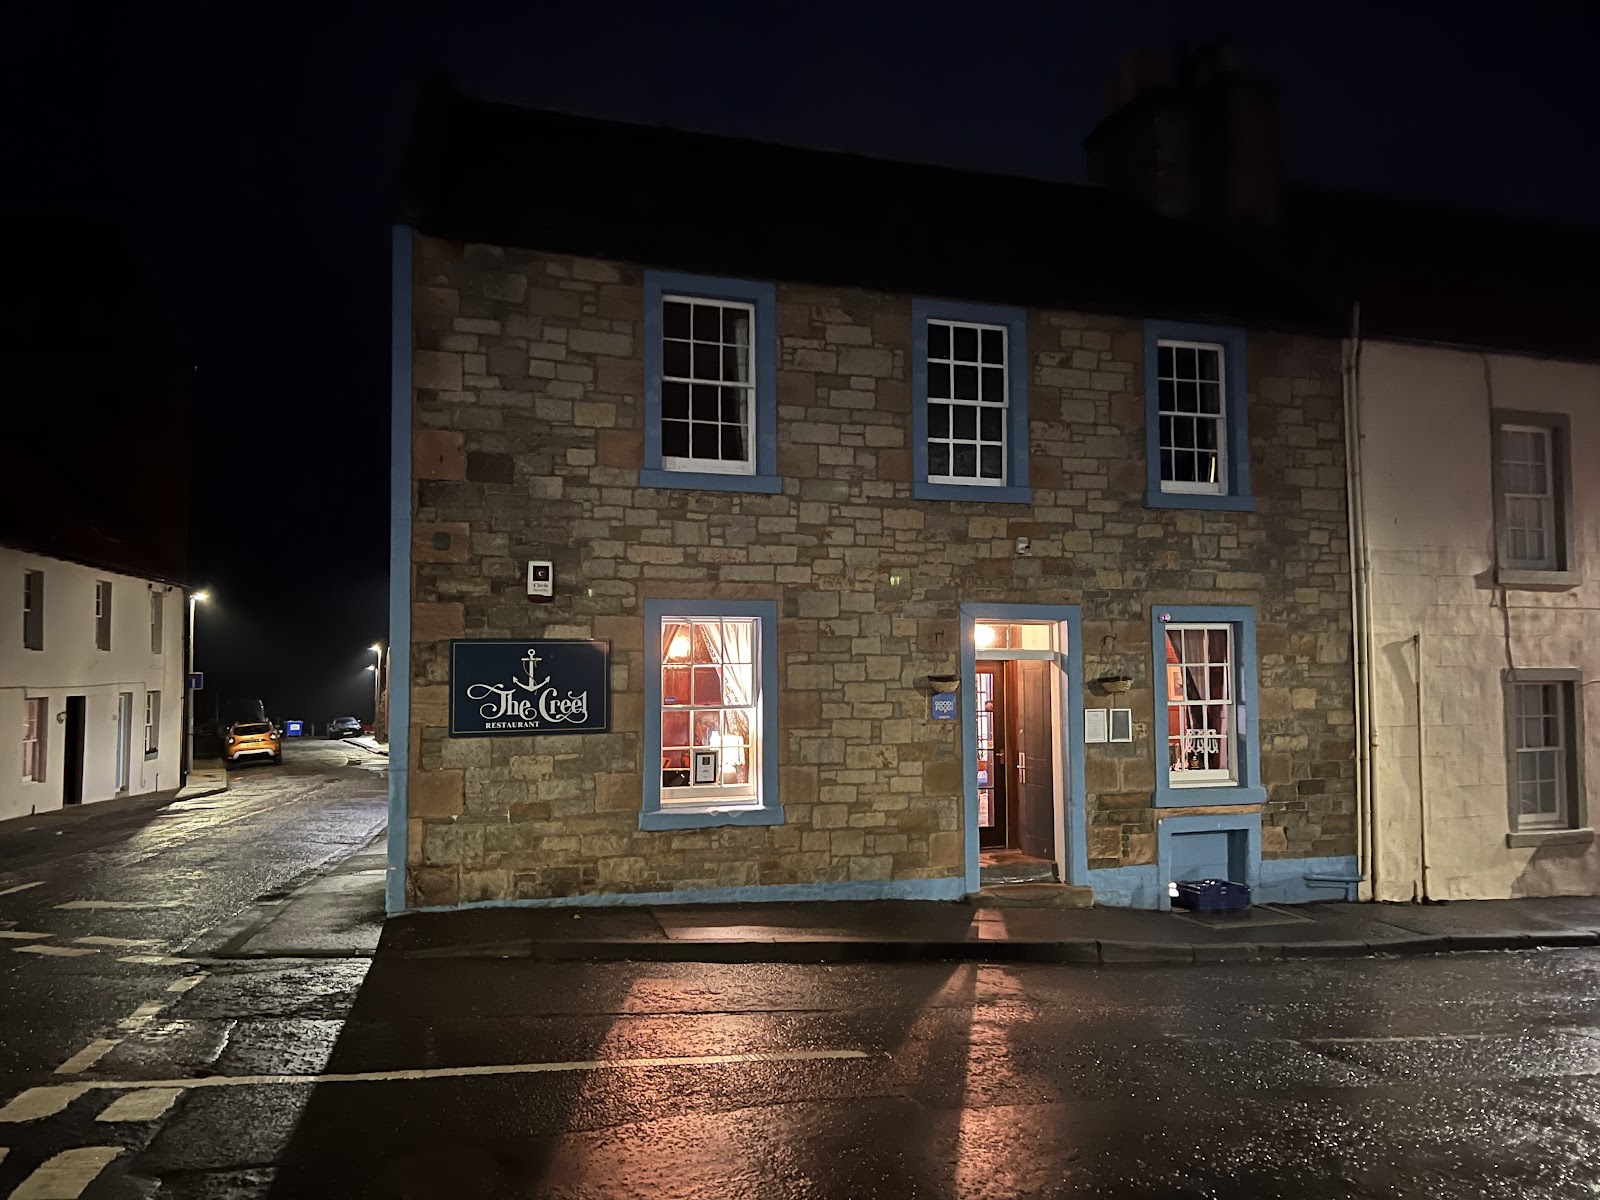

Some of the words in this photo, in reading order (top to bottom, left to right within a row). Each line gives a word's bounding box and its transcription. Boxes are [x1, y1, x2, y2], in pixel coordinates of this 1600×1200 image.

[466, 683, 538, 721] The
[538, 687, 589, 724] Creel
[485, 721, 540, 729] RESTAURANT
